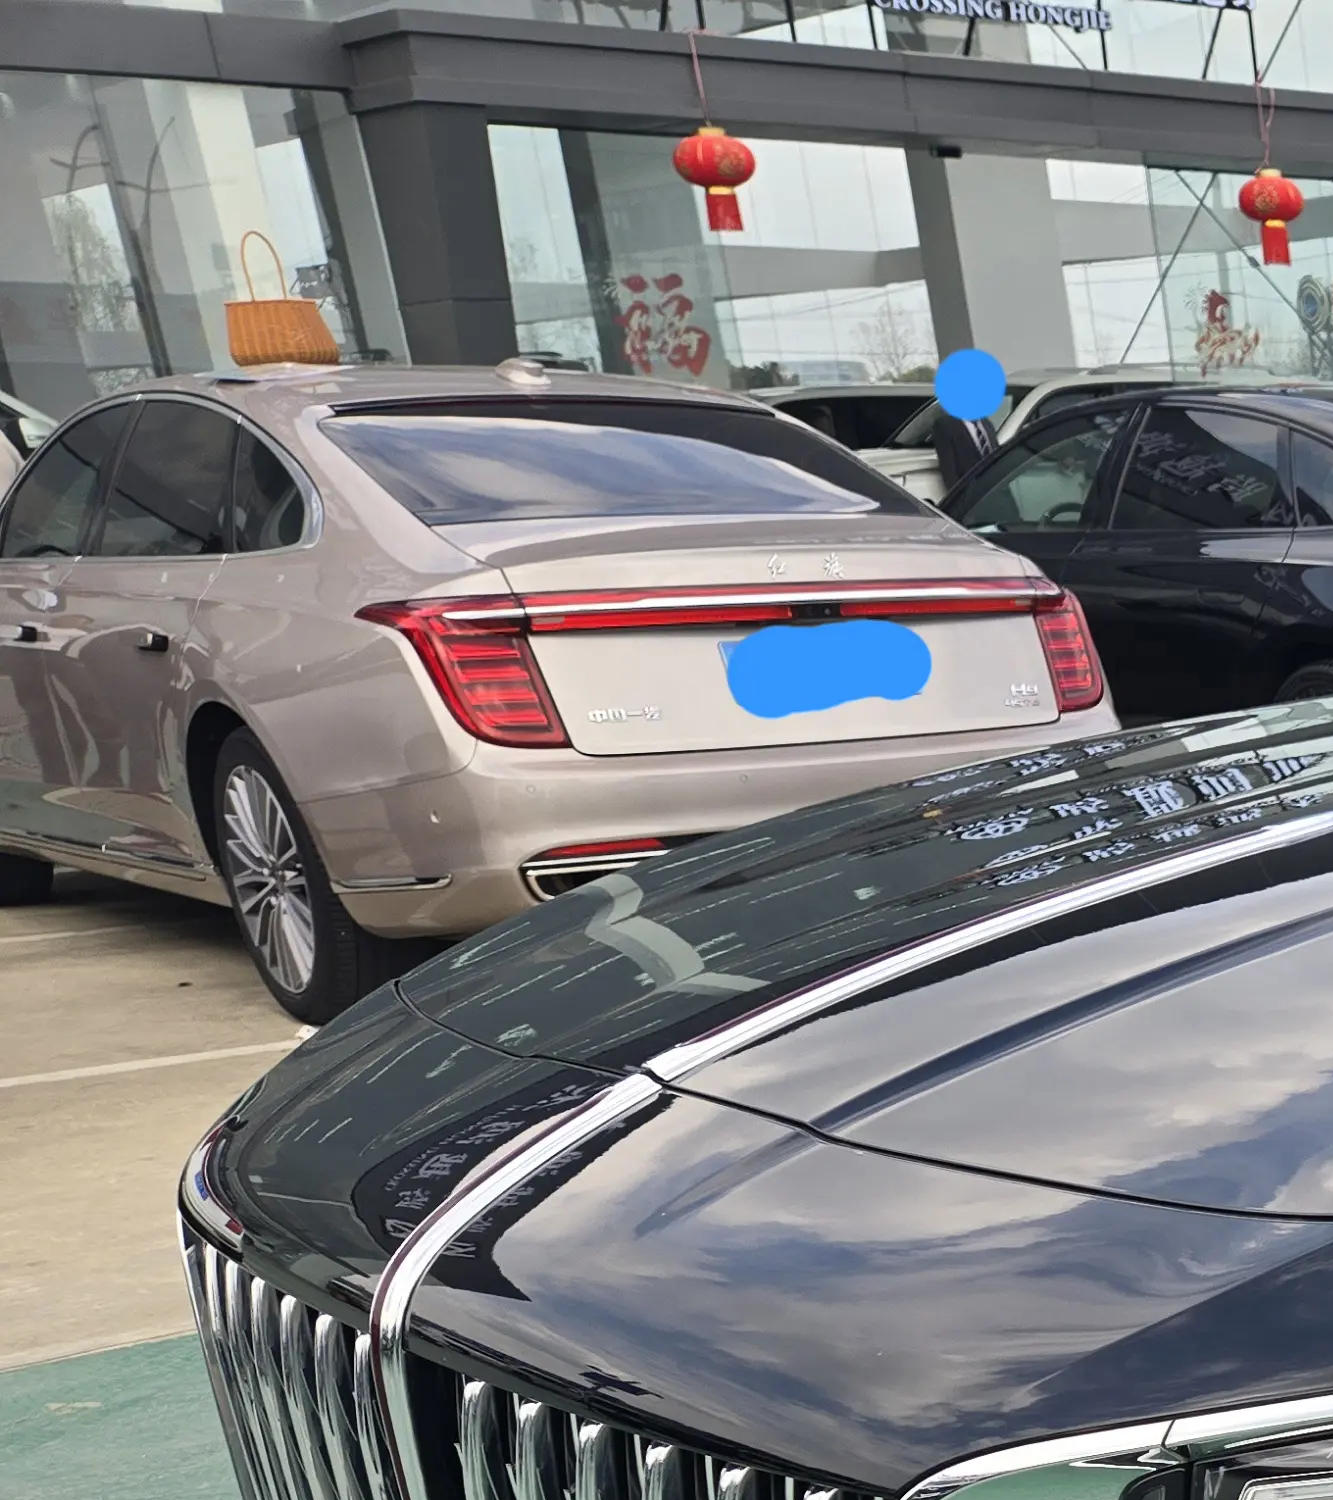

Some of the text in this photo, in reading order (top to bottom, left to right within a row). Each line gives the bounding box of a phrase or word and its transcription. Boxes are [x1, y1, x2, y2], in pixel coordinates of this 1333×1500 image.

[1009, 1, 1112, 31] HONGJIE
[587, 704, 661, 722] 中国一汽
